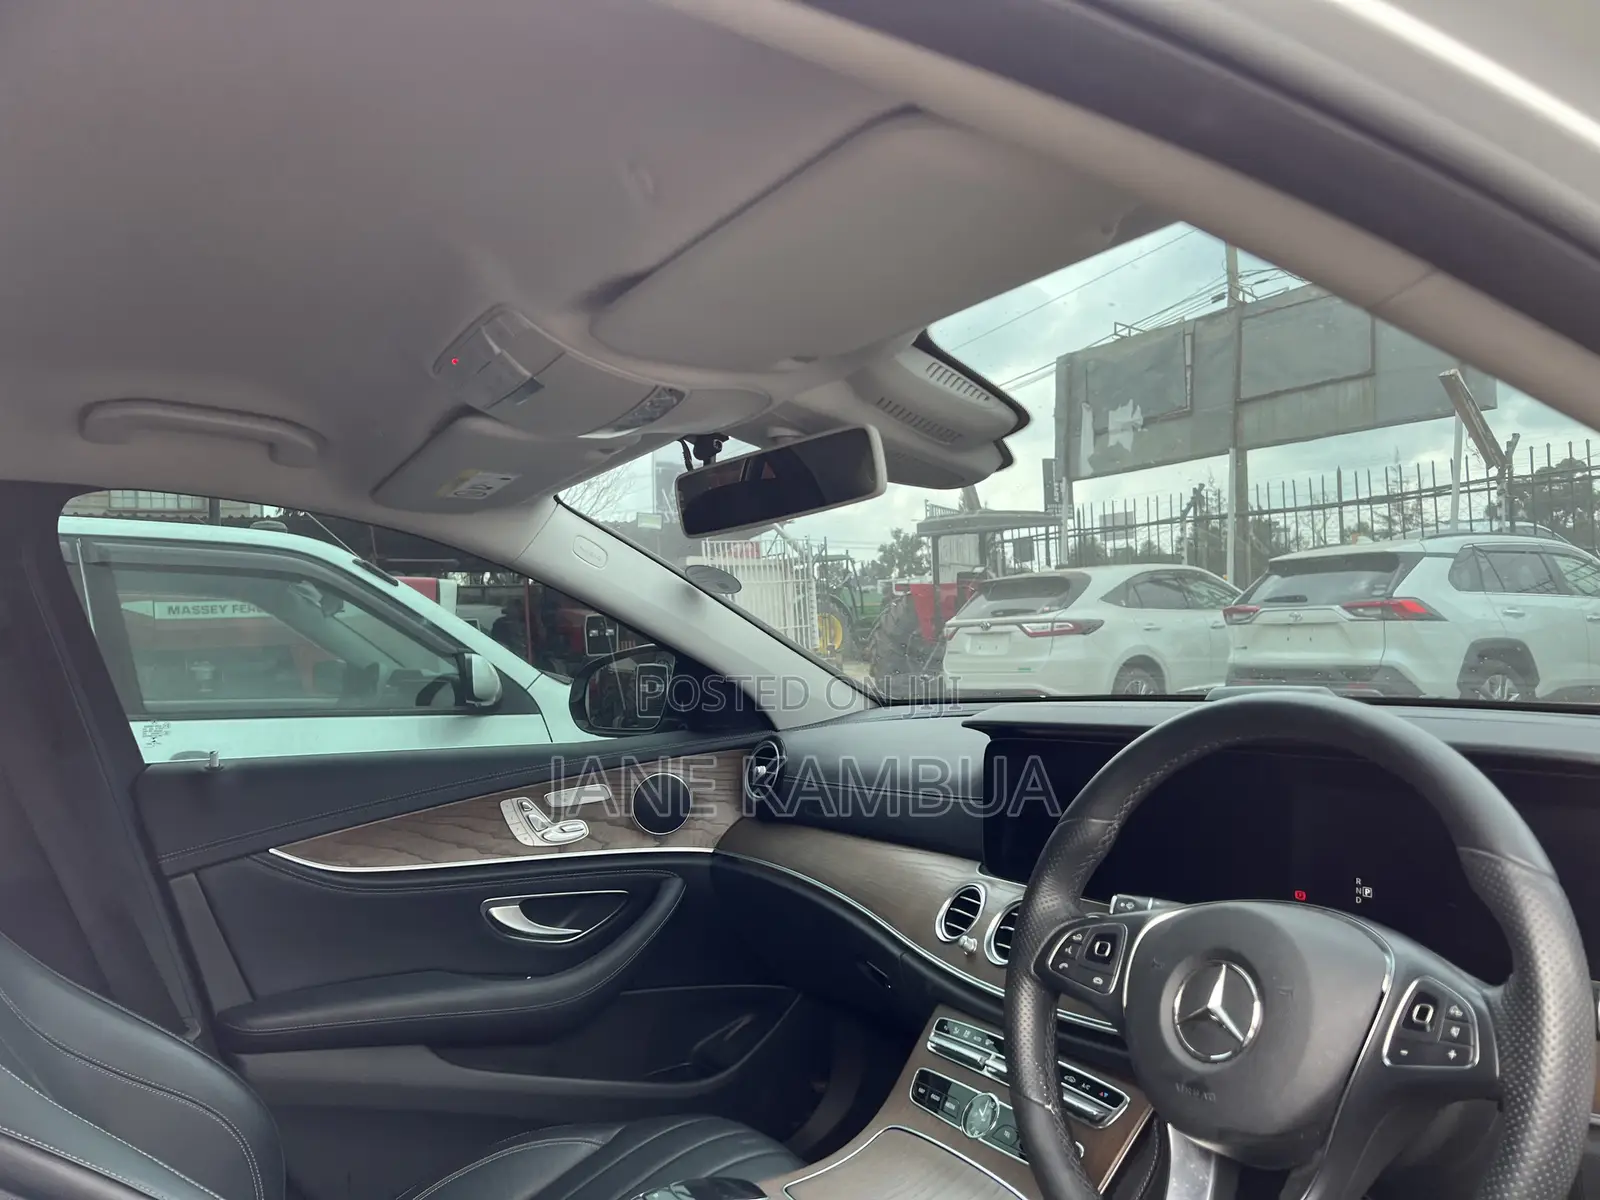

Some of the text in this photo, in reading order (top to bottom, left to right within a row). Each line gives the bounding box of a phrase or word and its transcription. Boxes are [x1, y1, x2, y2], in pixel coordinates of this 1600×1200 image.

[167, 604, 228, 616] MASSEY
[1355, 877, 1362, 885] R
[1355, 887, 1362, 895] N
[1355, 896, 1362, 904] D
